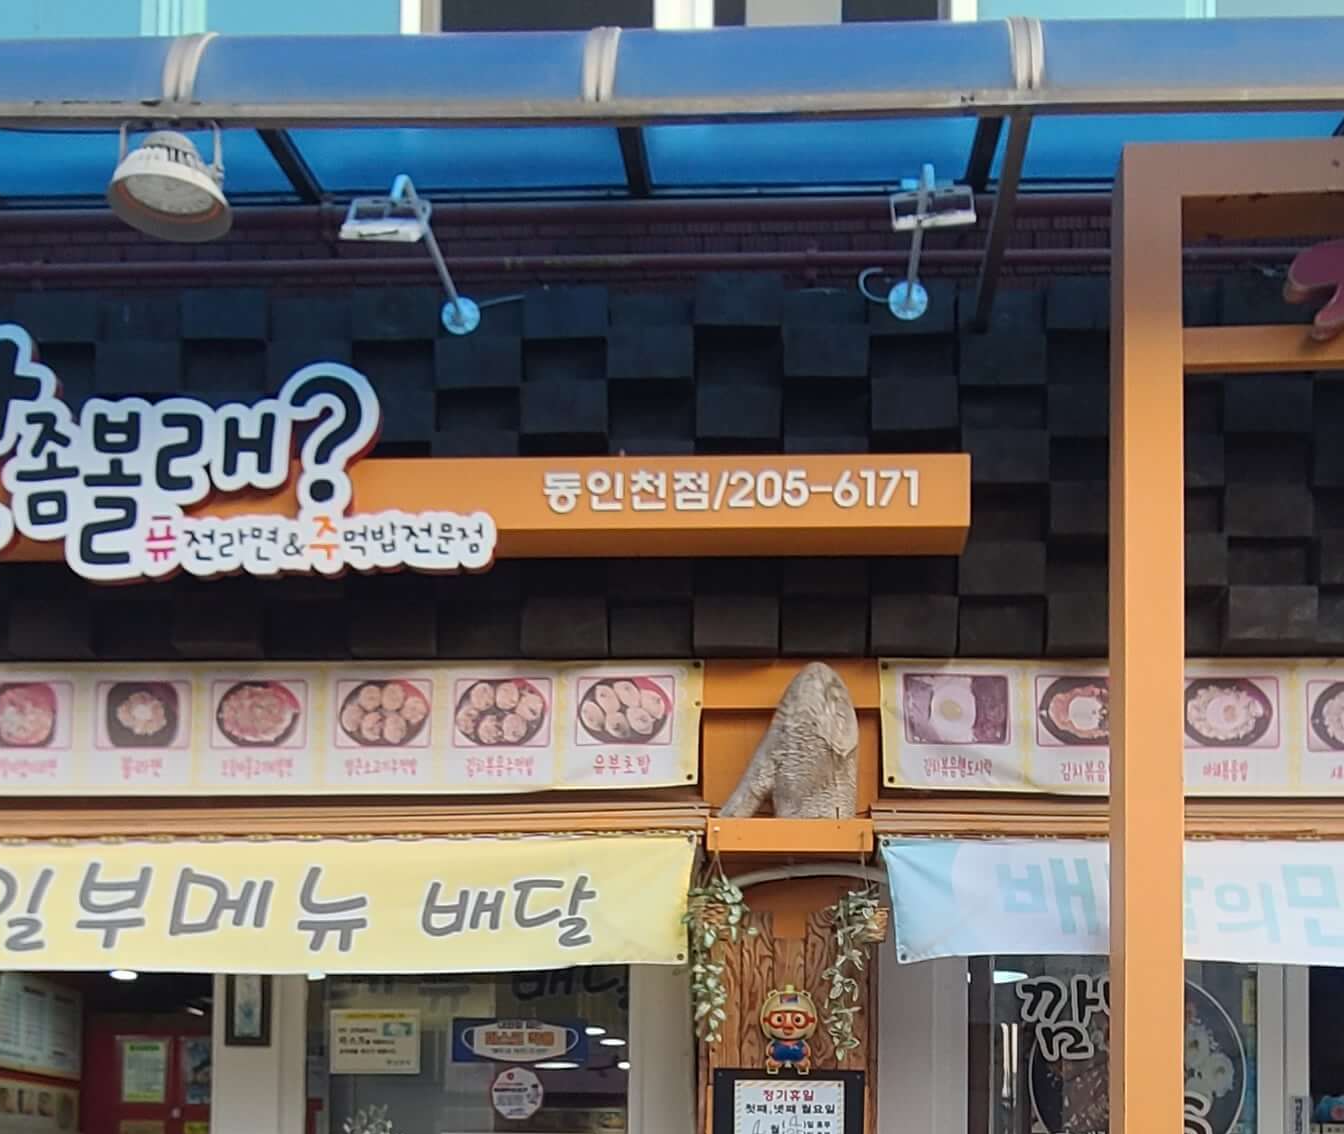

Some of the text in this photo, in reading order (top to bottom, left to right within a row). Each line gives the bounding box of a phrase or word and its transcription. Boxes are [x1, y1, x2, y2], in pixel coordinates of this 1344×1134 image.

[543, 469, 920, 513] 동인천점/205-6171
[592, 753, 651, 775] 유부초밥
[1061, 760, 1106, 783] 김치볶음
[420, 872, 597, 948] 배달
[763, 1089, 815, 1102] 정기휴일
[801, 1104, 836, 1115] 월요일
